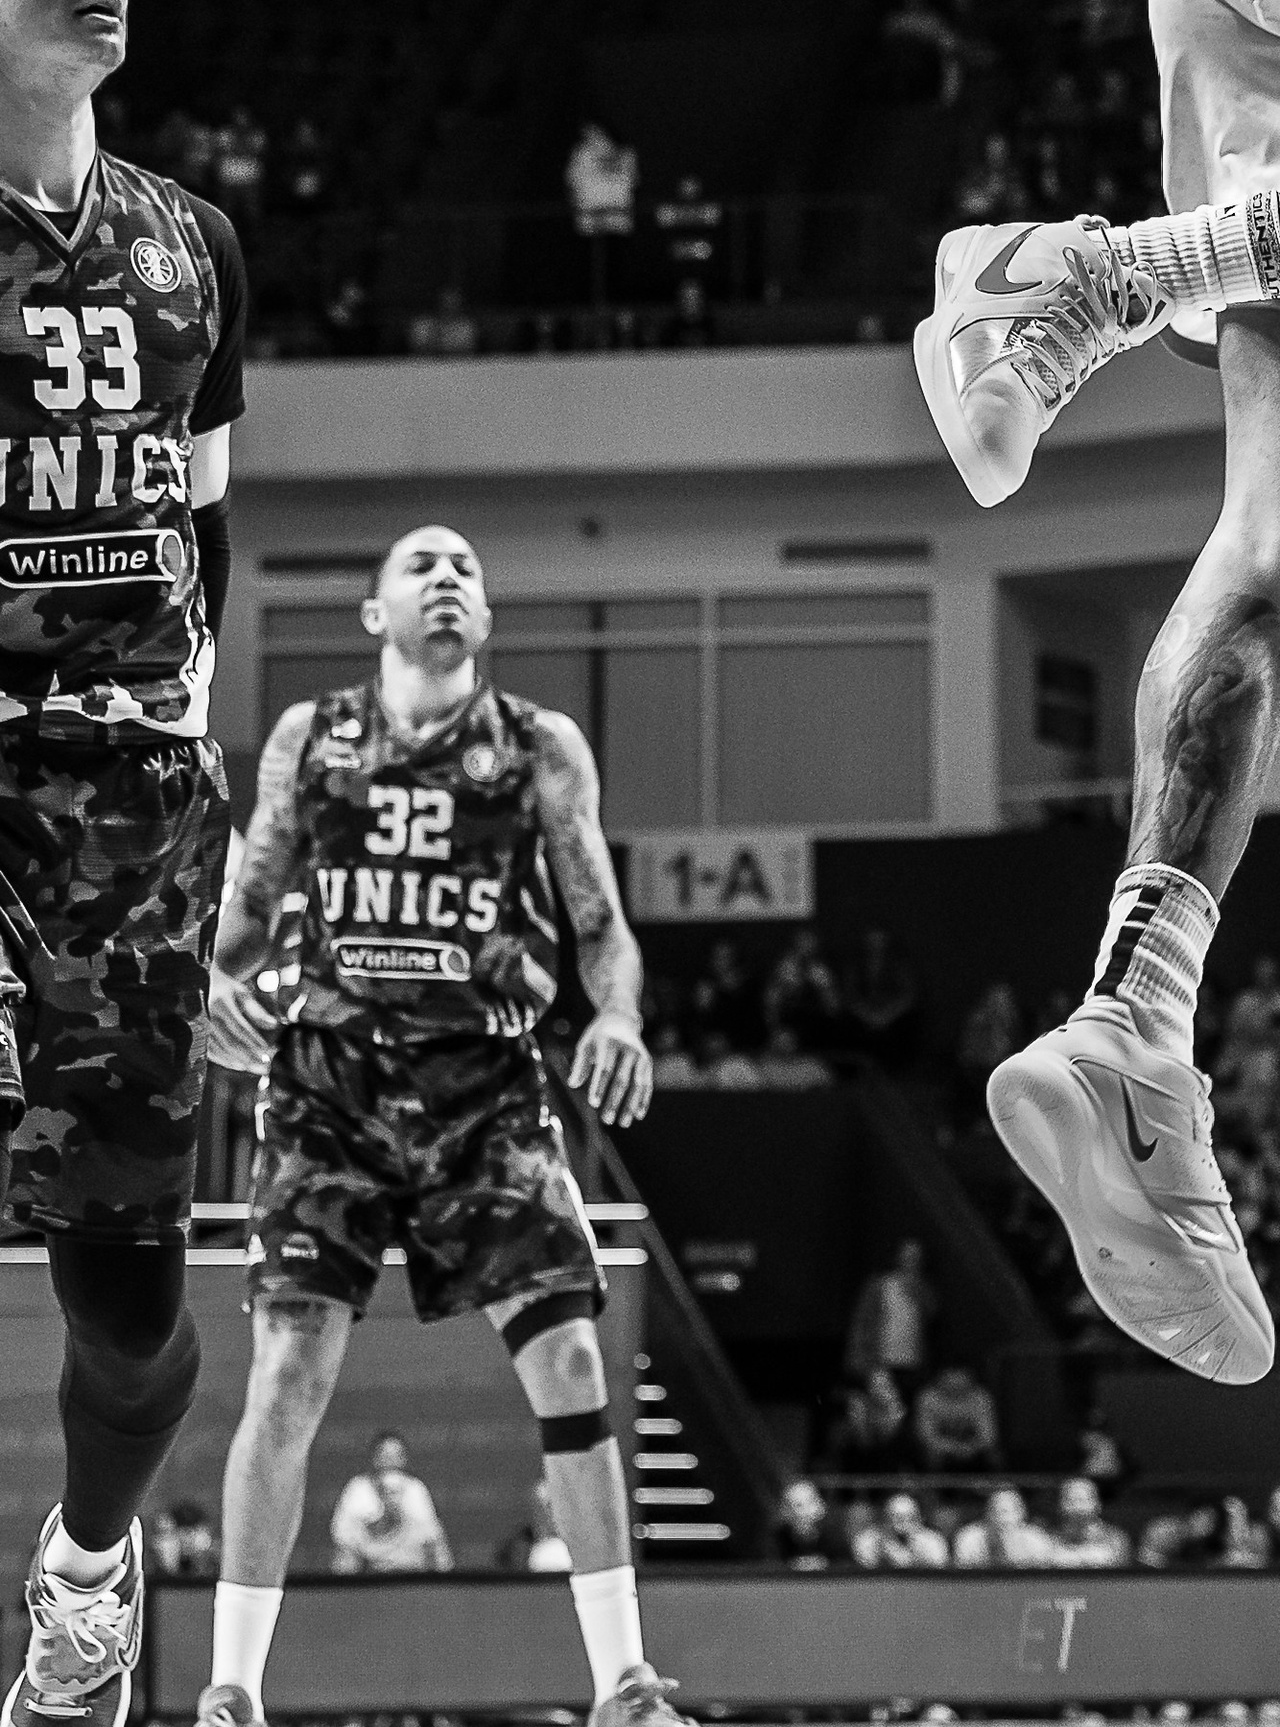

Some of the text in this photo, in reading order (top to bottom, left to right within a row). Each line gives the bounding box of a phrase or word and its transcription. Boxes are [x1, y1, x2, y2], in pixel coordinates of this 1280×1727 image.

[1252, 191, 1280, 299] UTHENTICS
[22, 306, 141, 411] 33
[9, 546, 149, 575] Winline
[364, 784, 455, 861] 32
[316, 867, 502, 933] UNICS
[339, 947, 438, 970] Winline
